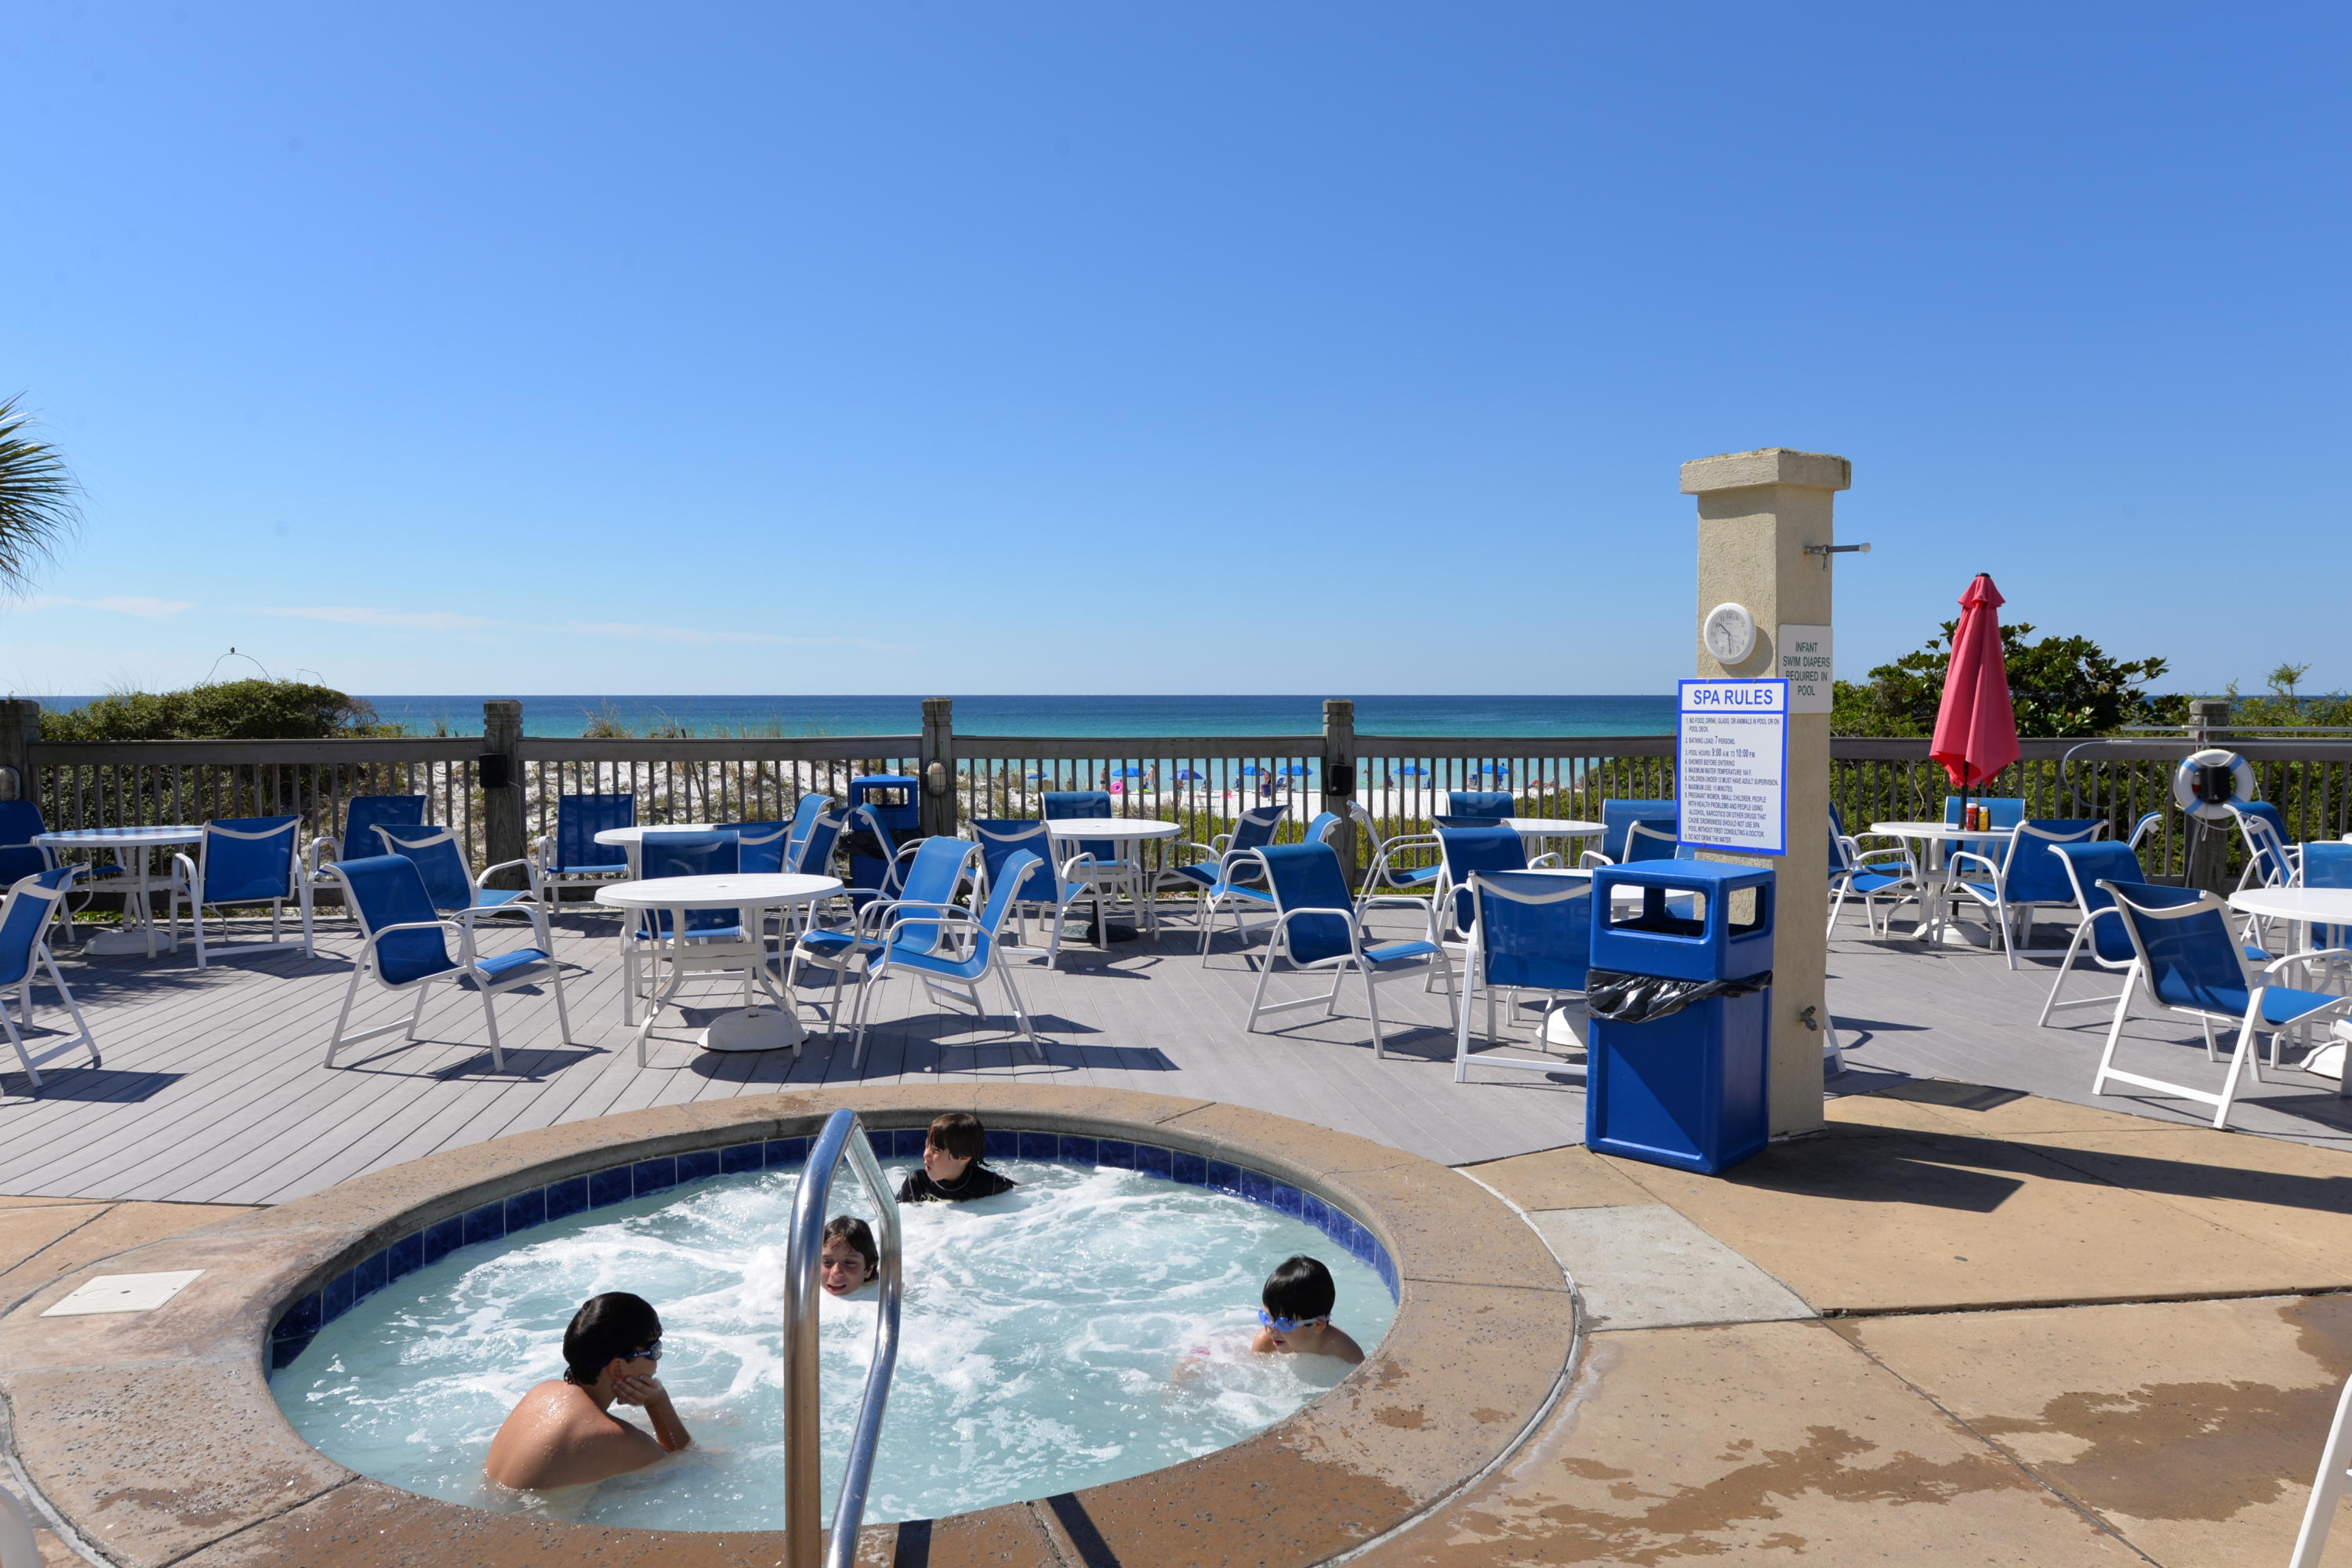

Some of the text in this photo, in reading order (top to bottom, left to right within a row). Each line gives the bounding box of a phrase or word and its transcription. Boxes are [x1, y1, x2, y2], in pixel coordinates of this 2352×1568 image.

[1796, 642, 1818, 653] INFANT
[1783, 656, 1830, 667] SWIM DIAPERS
[1786, 671, 1827, 682] REQUIRED IN
[1798, 685, 1815, 696] POOL
[1694, 689, 1772, 705] SPA RULES
[1715, 735, 1718, 744] 7
[1736, 749, 1749, 758] 10:00
